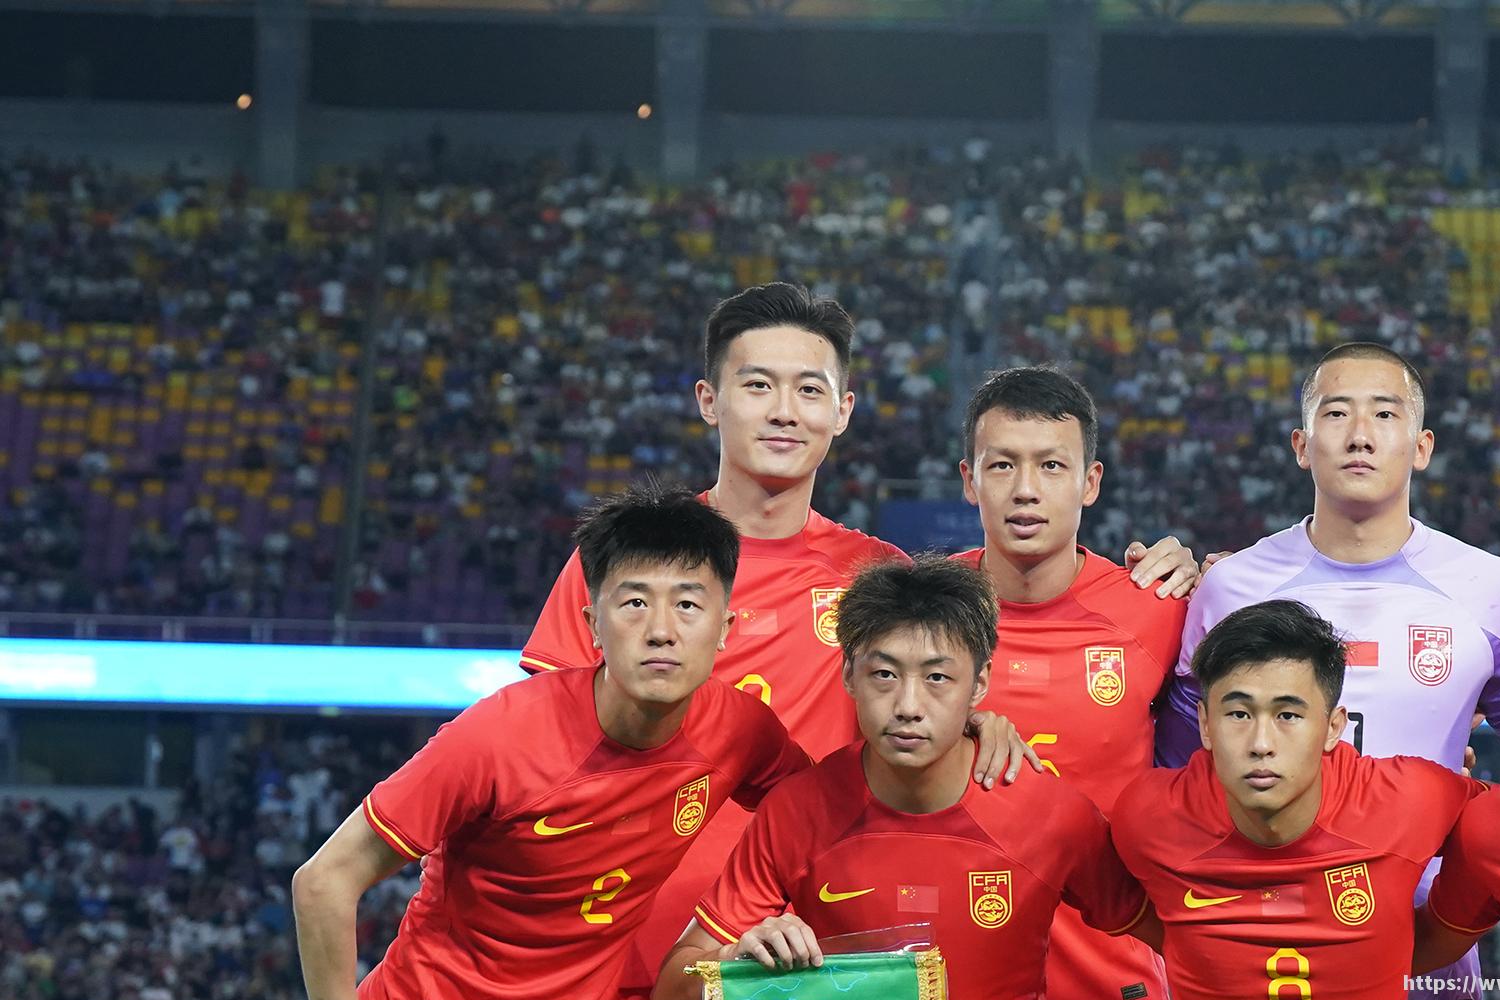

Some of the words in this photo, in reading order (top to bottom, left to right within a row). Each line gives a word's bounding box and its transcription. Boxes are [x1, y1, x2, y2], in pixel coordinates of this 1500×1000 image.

[1414, 631, 1446, 642] CFA
[1090, 651, 1120, 662] CFA
[679, 780, 706, 798] CFA
[973, 874, 1007, 886] CFA
[1330, 866, 1364, 884] CFA
[580, 868, 630, 923] 2
